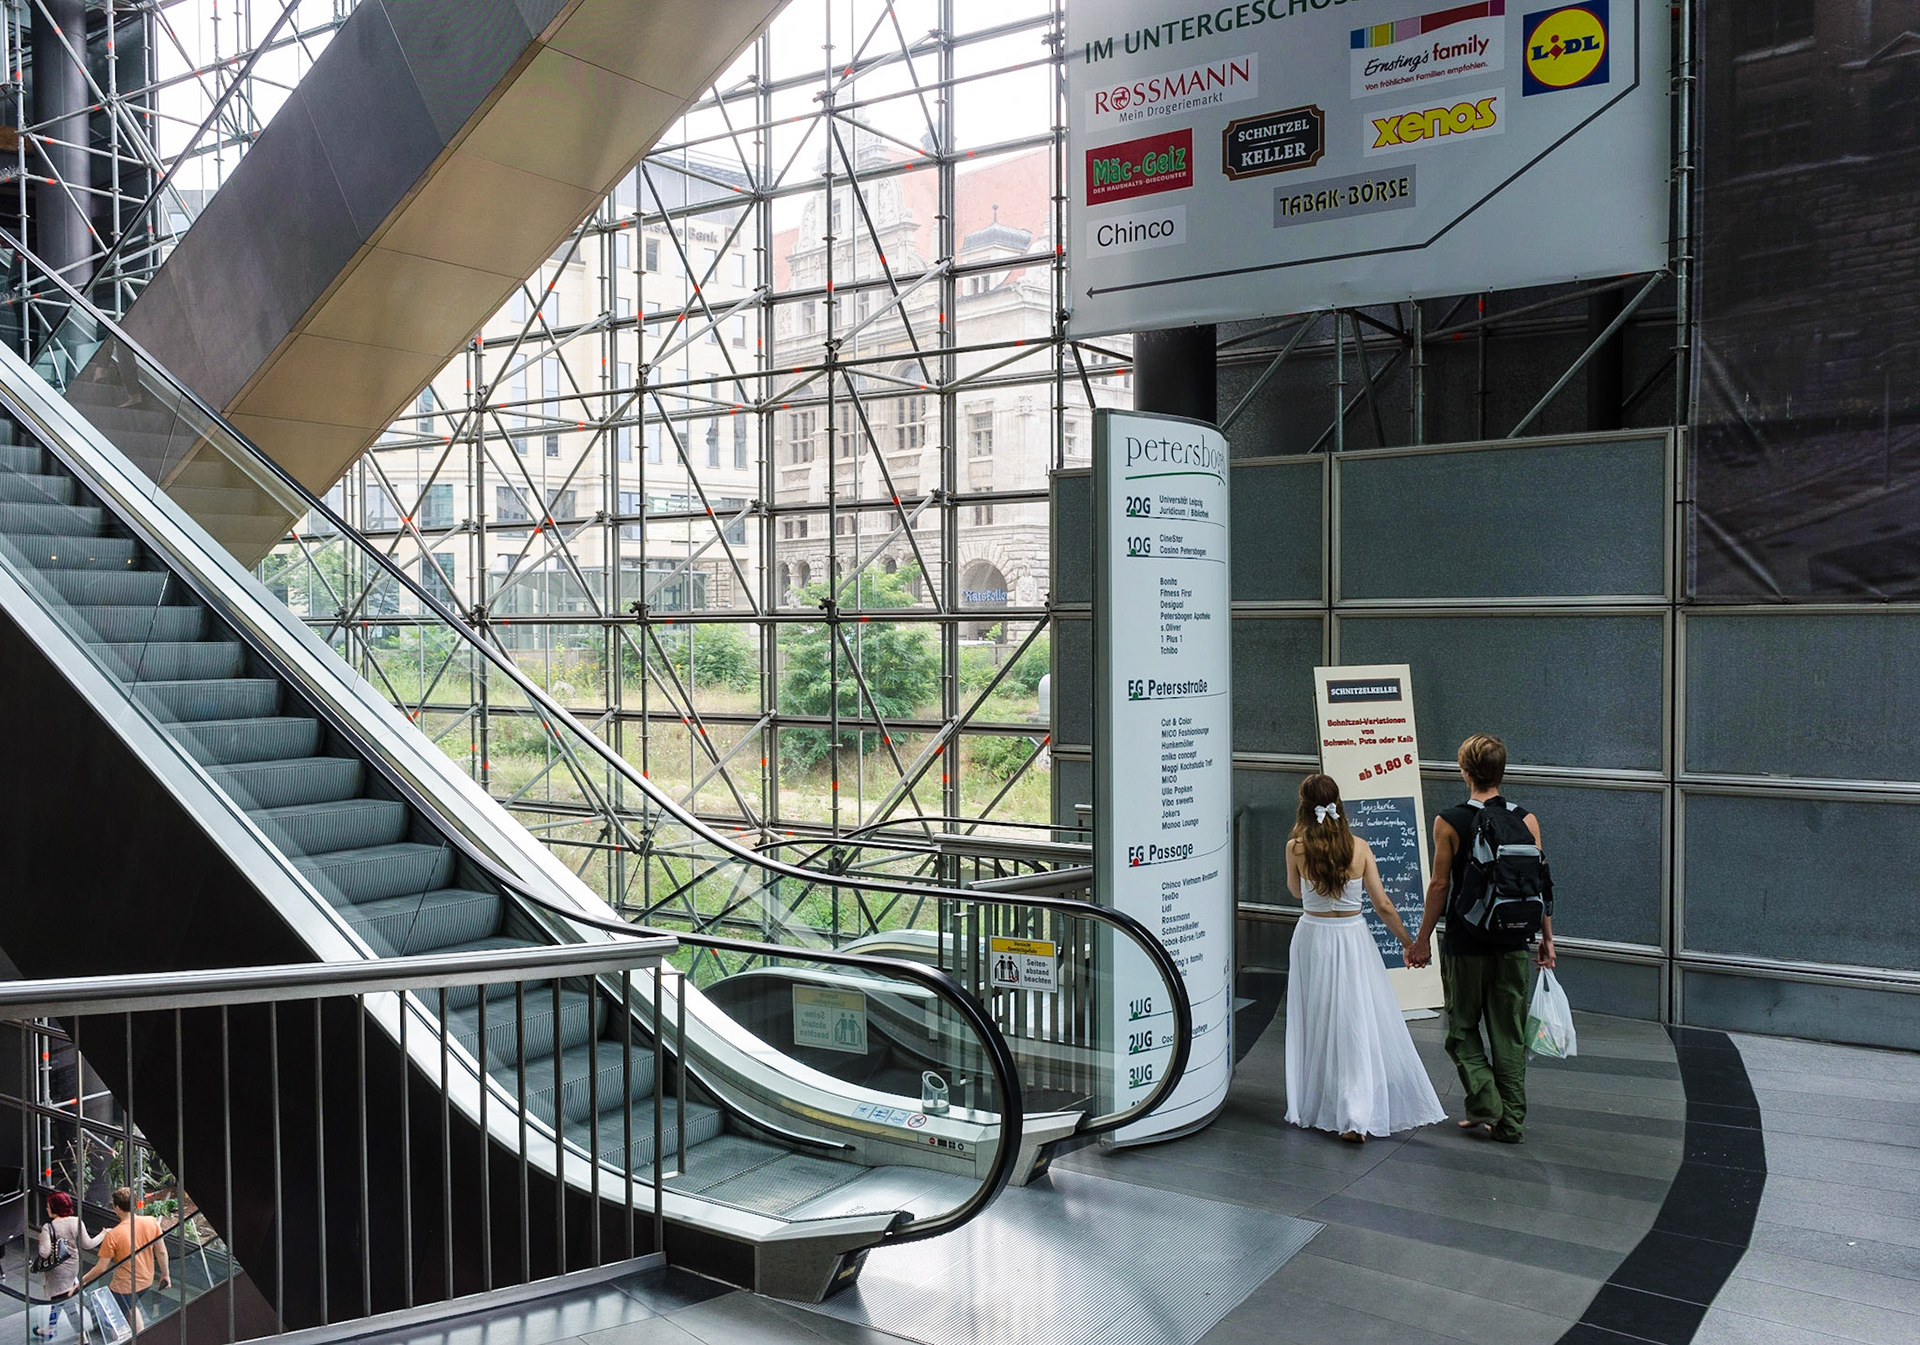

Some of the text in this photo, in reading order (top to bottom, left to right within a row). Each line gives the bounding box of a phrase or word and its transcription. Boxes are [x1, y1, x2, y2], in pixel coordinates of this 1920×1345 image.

[1085, 0, 1357, 64] IM UNTERGESCH
[1364, 34, 1490, 76] Ernsting's family
[1365, 61, 1489, 91] Von fröhlichen Familien empfohlen.
[1095, 58, 1250, 115] ROSSMANN
[1119, 92, 1224, 123] Mein Drogeriemarkt
[1372, 96, 1498, 149] xenos
[1238, 118, 1310, 142] SCHNITZEL
[1241, 142, 1307, 167] KELLER
[1093, 145, 1186, 187] Mäc-Geiz
[1093, 171, 1187, 195] DER HAUSHALTS-DISCOUNTER
[1280, 177, 1410, 217] TABAK-BÖRSE
[688, 227, 719, 243] Bank
[1097, 219, 1175, 247] Chinco
[1160, 534, 1184, 543] CineStar
[1160, 545, 1179, 554] Casino
[1160, 589, 1193, 597] Fitness First
[1160, 600, 1184, 610] Desigual
[1160, 612, 1193, 621] Petersbogen
[1166, 635, 1178, 643] Plus
[1161, 646, 1178, 655] Tchibo
[1128, 679, 1208, 696] EG Petersstraße
[1330, 686, 1398, 695] SCHNITZELKELLER
[1161, 717, 1192, 727] Cut & Color
[1161, 729, 1177, 738] MICO
[1161, 740, 1194, 750] Hunkemöller
[1359, 737, 1377, 745] Pute
[1397, 735, 1414, 743] Kalb
[1161, 764, 1179, 773] Maggi
[1359, 768, 1373, 781] ab
[1404, 754, 1413, 765] €
[1161, 775, 1177, 784] MICO
[1161, 785, 1193, 795] Ulla Popken
[1161, 796, 1194, 807] Viba sweets
[1161, 810, 1180, 819] Jokers
[1182, 818, 1199, 827] Lounge
[1128, 843, 1193, 863] EG Passage
[1161, 881, 1181, 890] Chinco
[1161, 904, 1172, 913] Lidl
[1161, 912, 1190, 924] Rossmann
[1161, 921, 1199, 936] Schnitzelkeller
[1026, 959, 1048, 967] Seiten-
[1026, 968, 1049, 976] abstand
[1024, 975, 1052, 984] beachten
